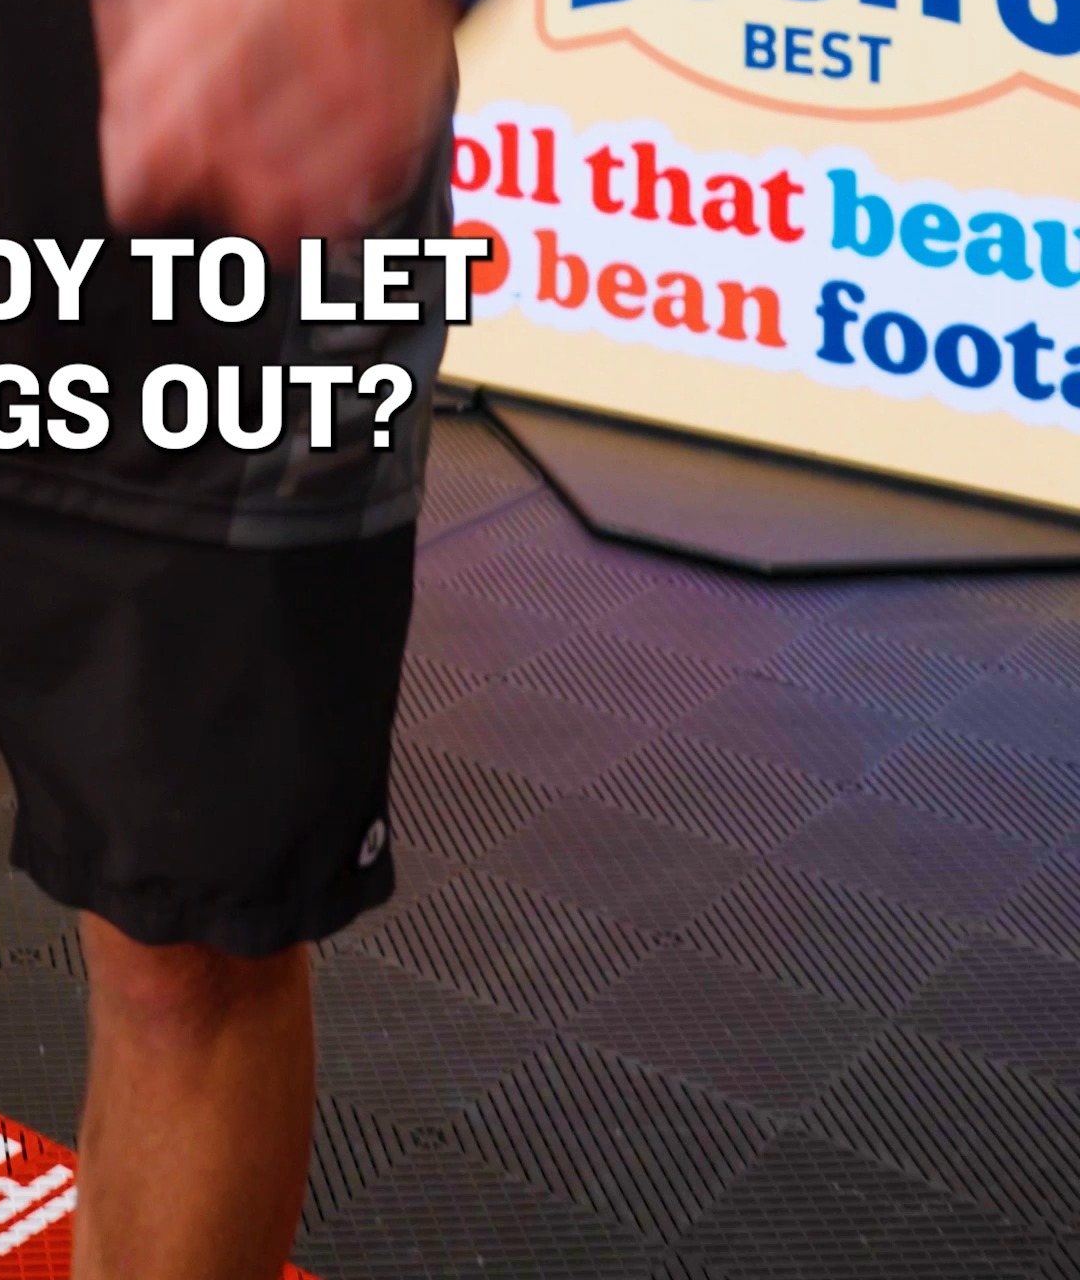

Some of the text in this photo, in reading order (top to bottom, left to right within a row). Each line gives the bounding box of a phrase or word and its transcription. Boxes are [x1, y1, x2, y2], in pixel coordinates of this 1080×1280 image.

[744, 21, 892, 84] BEST
[583, 141, 806, 242] that
[533, 228, 788, 349] bean
